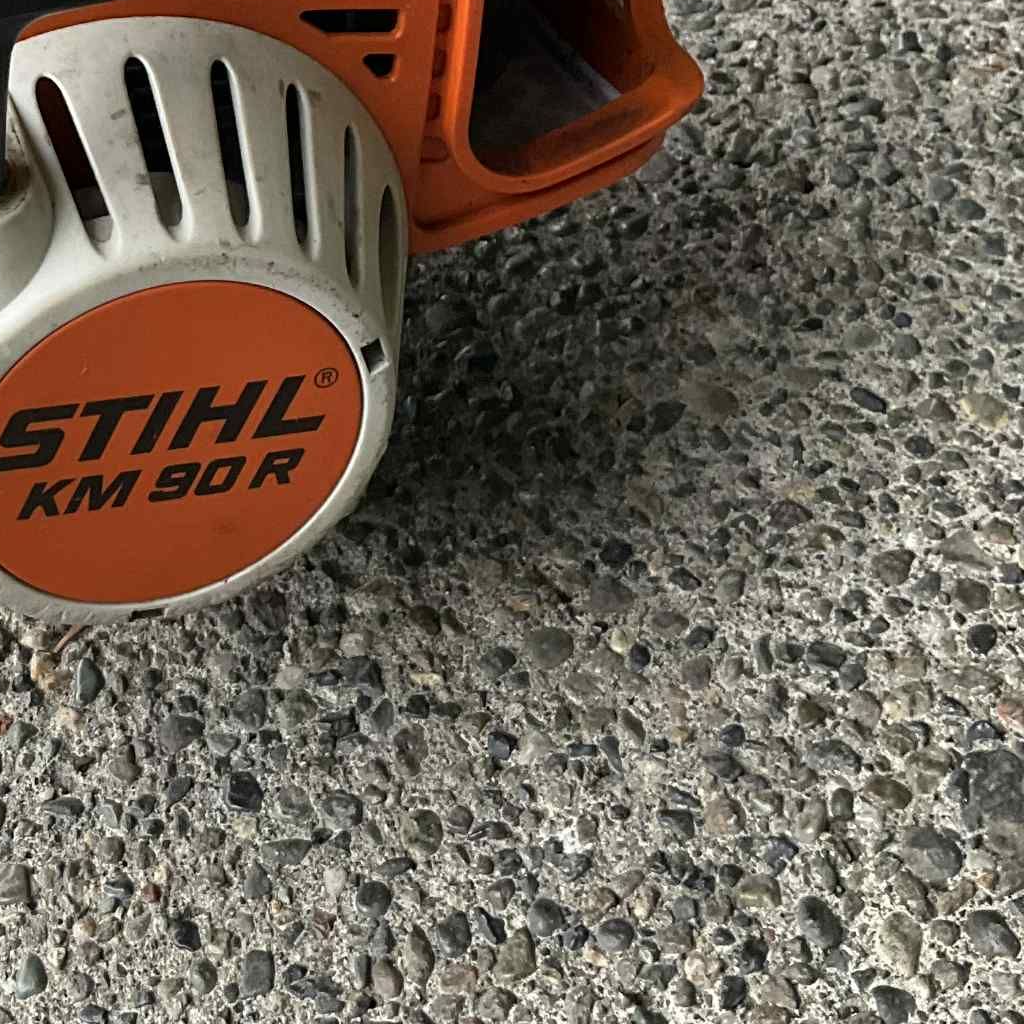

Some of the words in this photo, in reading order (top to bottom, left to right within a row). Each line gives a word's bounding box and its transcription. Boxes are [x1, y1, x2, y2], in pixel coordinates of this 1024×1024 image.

[17, 470, 142, 520] KM
[148, 456, 247, 503] 90
[248, 448, 305, 489] R
